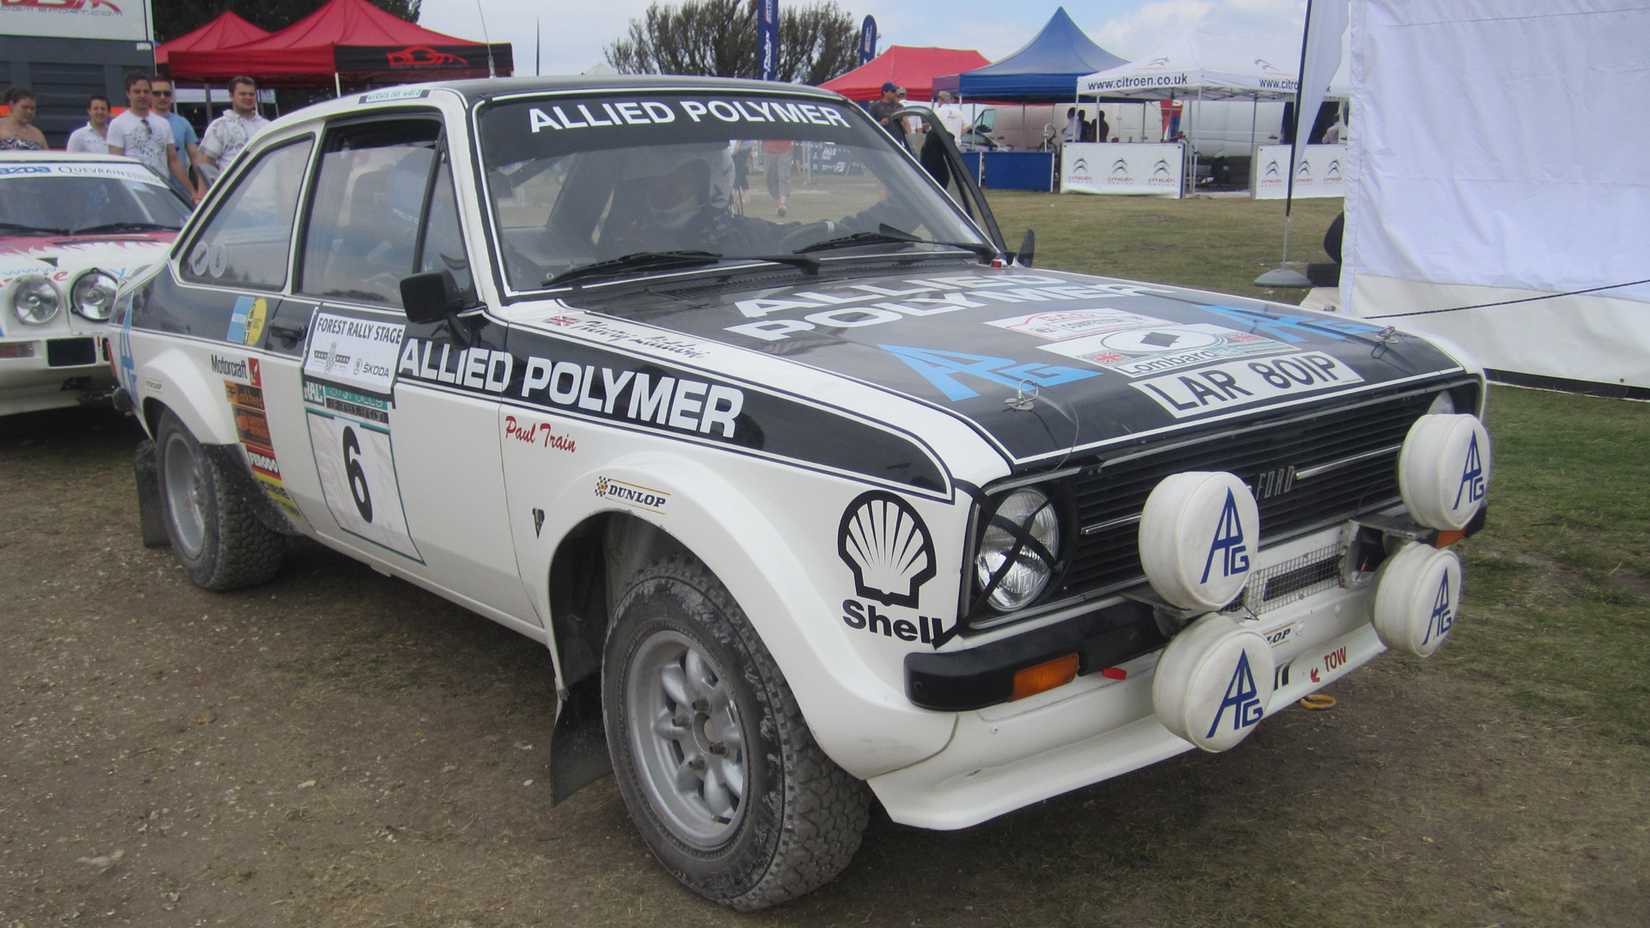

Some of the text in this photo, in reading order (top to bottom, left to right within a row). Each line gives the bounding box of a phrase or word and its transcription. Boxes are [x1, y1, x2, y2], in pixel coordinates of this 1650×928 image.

[1088, 73, 1188, 91] www.citroen.co.uk
[1258, 77, 1299, 90] www.citro
[529, 100, 851, 133] ALLIED POLYMER
[722, 282, 1178, 341] POLYMER
[734, 274, 1077, 318] ALLIED
[316, 317, 403, 345] FOREST RALLY STAGE
[210, 353, 248, 379] Motorcraft
[399, 338, 745, 439] ALLIED POLYMER
[1143, 368, 1252, 411] LAR
[505, 415, 577, 454] Paul Train
[343, 425, 373, 524] 6
[609, 483, 667, 509] DUNLOP
[841, 598, 944, 649] Shell
[1323, 646, 1347, 672] TOW
